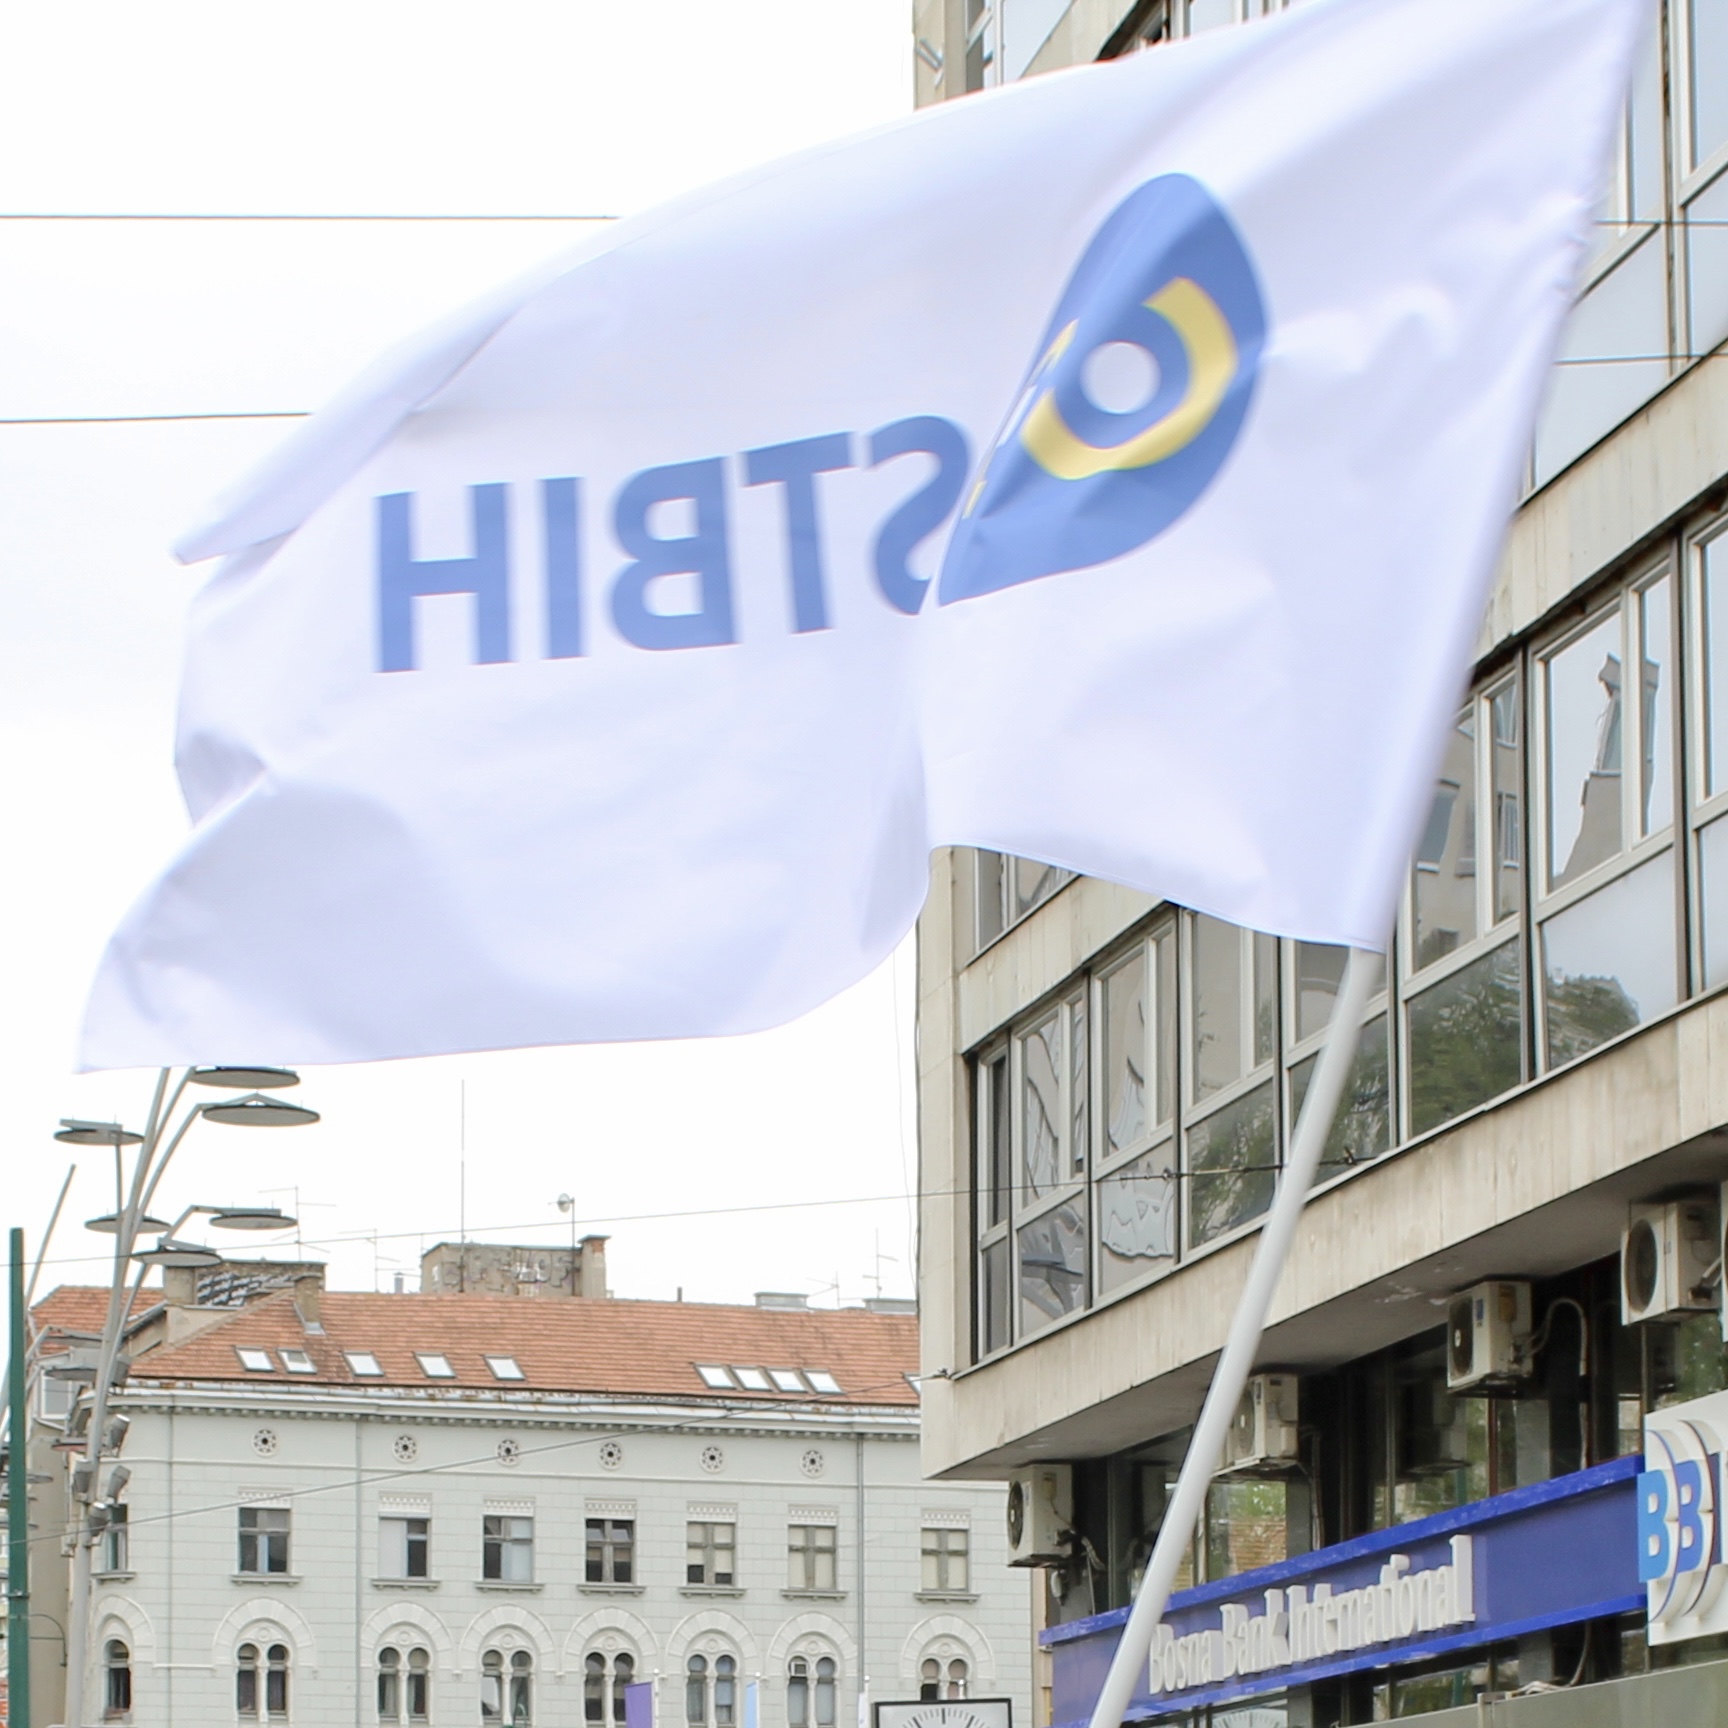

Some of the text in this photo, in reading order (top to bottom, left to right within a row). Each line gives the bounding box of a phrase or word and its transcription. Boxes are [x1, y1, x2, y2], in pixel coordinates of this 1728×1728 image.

[1148, 1533, 1477, 1696] Bosna Bank International
